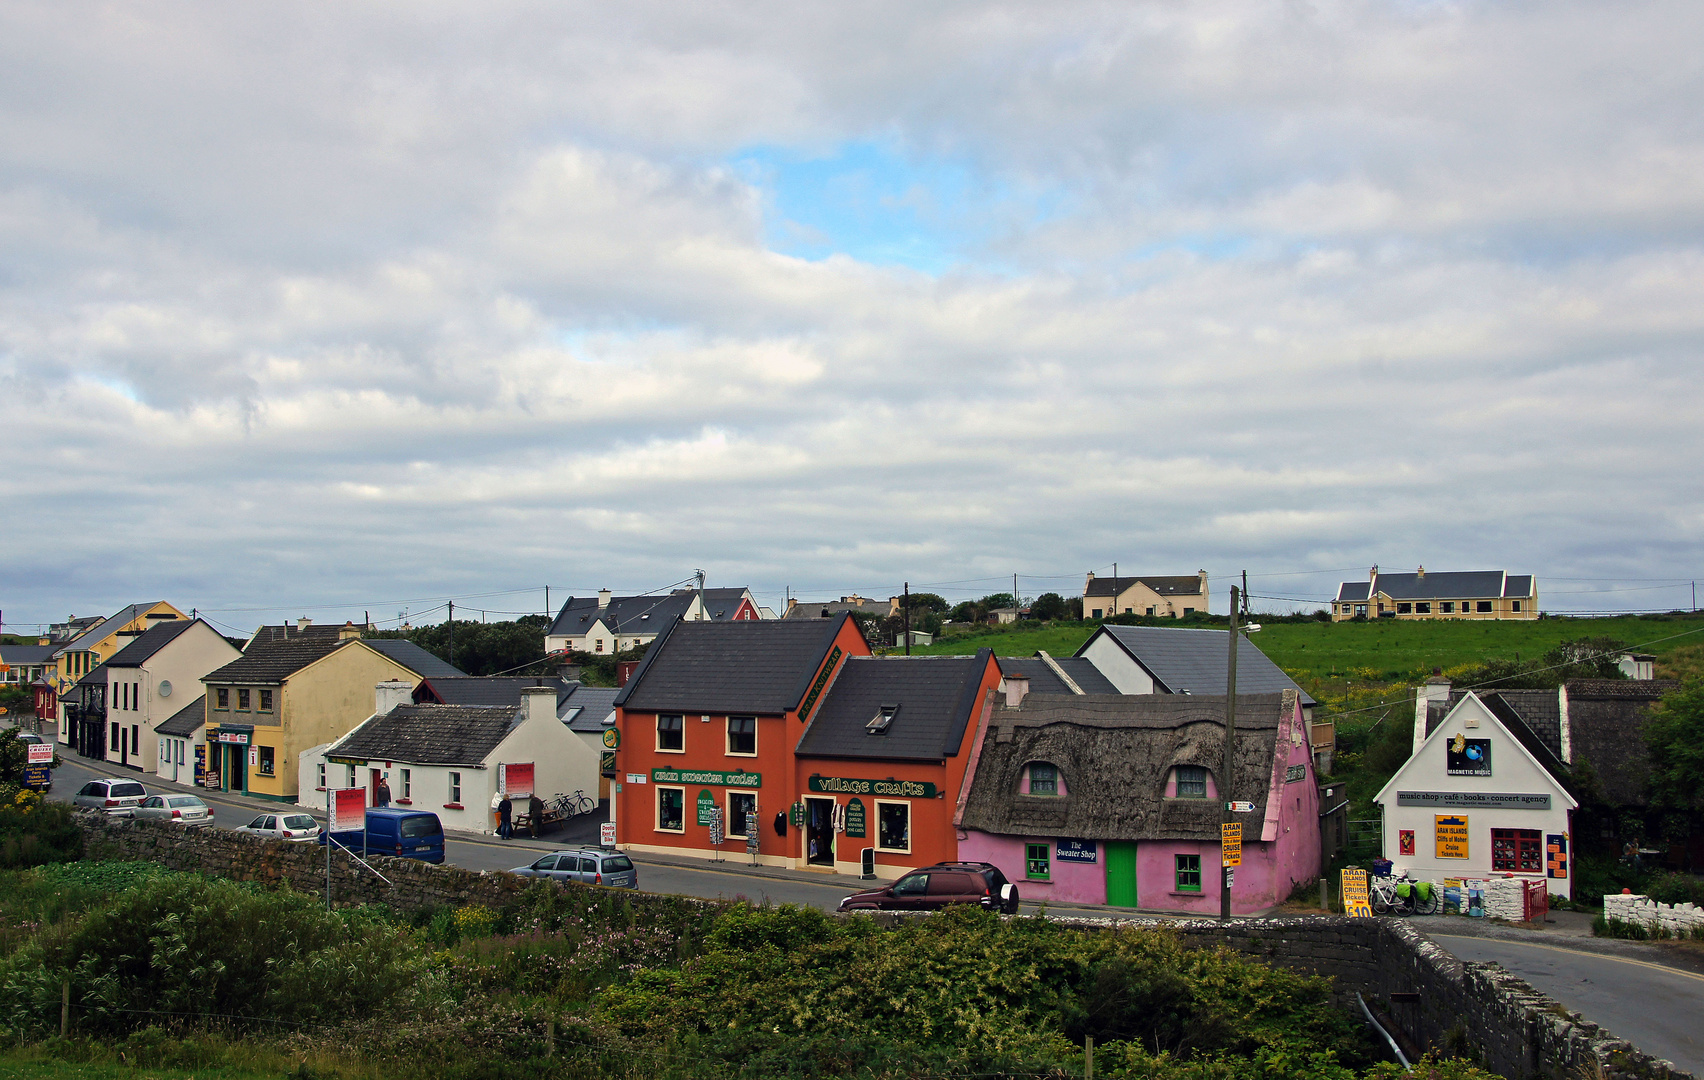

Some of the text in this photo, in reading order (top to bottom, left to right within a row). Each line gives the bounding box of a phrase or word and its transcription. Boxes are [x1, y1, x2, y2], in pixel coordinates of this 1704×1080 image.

[802, 651, 840, 718] ARAN KNITWEAR
[1057, 849, 1096, 860] Sweater Shop
